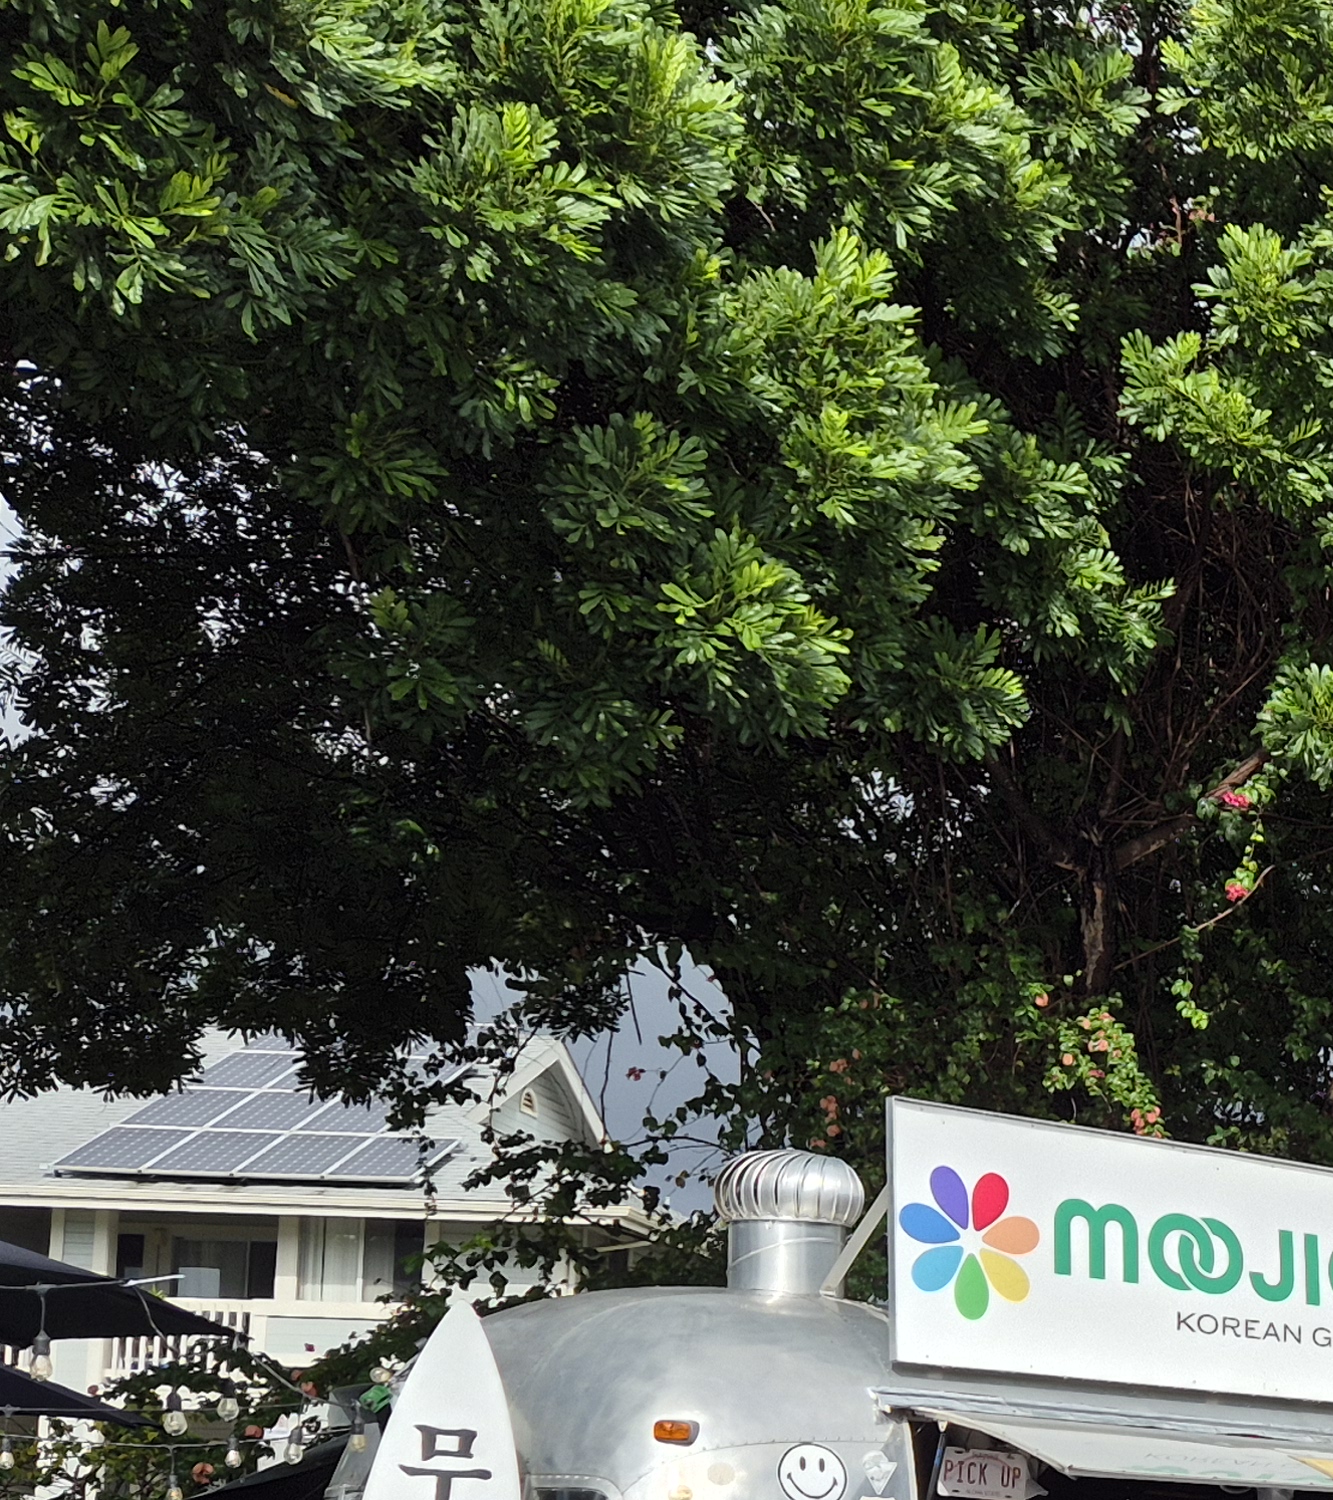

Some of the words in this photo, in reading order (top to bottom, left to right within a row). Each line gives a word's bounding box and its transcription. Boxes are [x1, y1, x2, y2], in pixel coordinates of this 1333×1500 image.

[1175, 1310, 1302, 1345] KOREAN
[944, 1459, 988, 1486] PICK
[1001, 1464, 1021, 1489] UP
